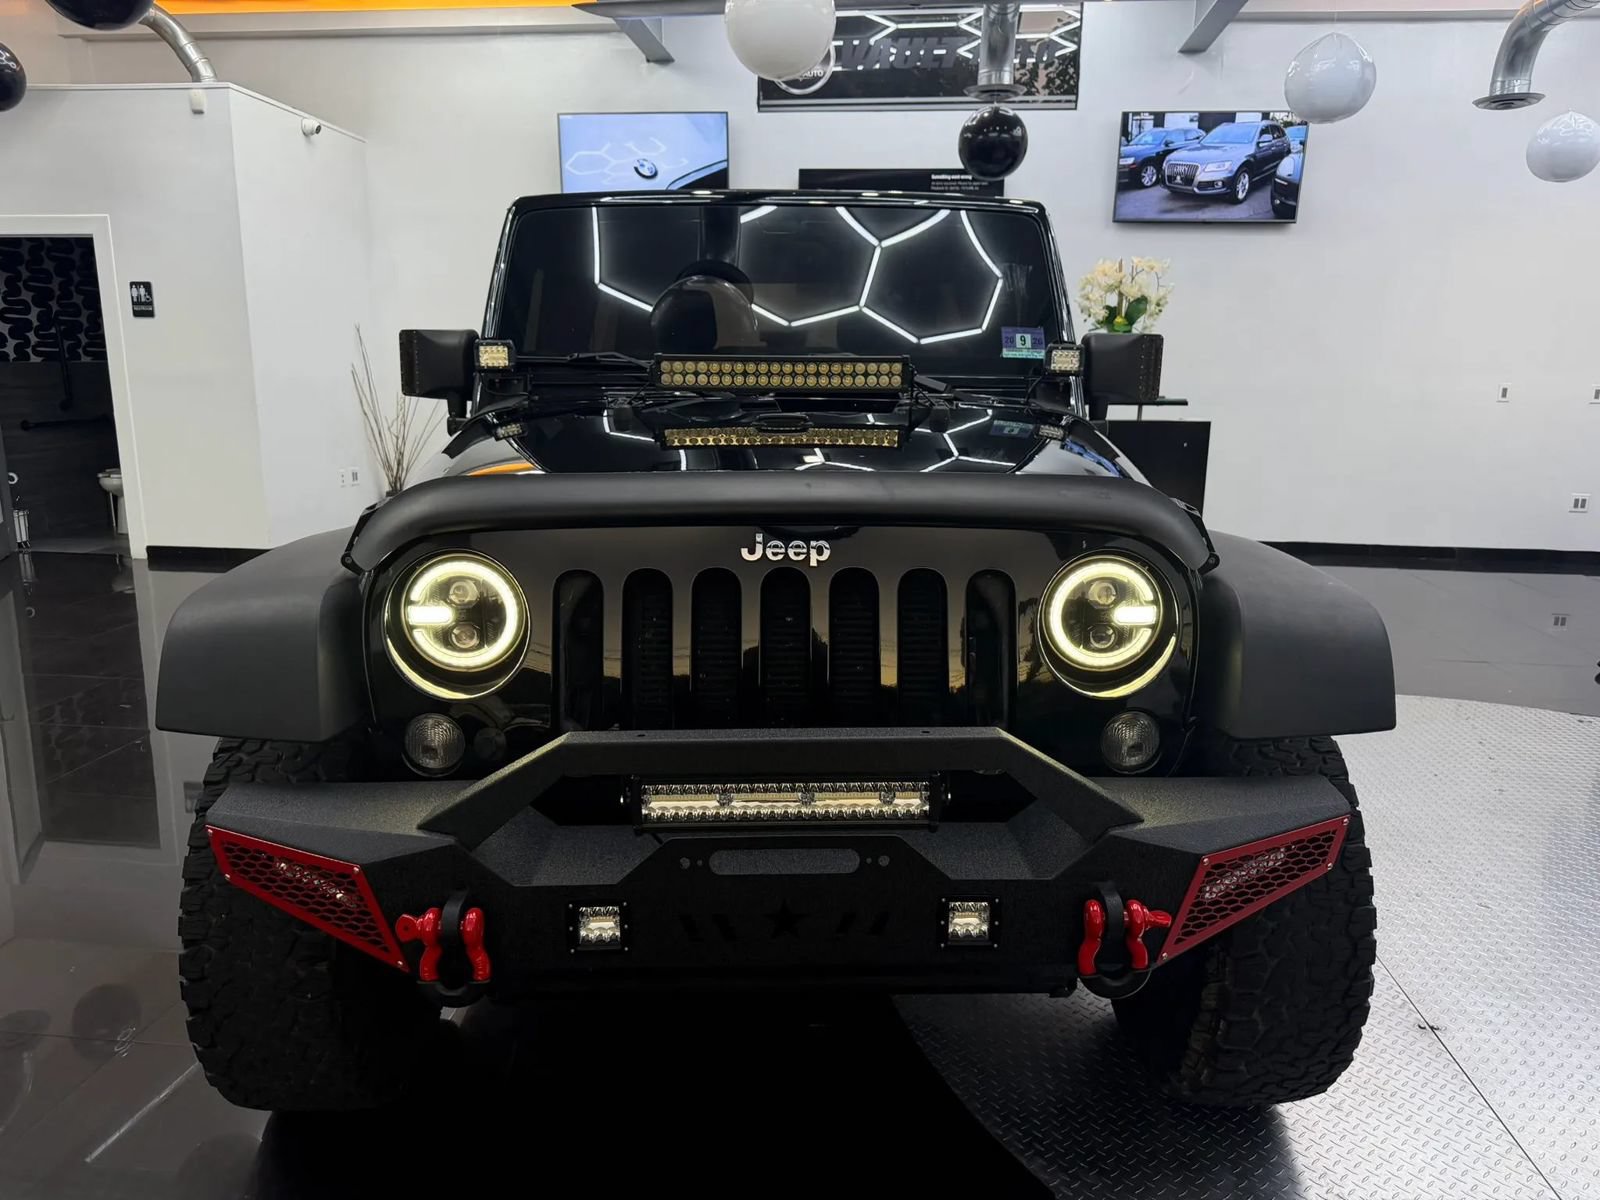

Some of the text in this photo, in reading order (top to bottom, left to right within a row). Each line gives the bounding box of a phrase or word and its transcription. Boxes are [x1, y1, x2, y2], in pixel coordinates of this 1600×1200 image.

[839, 37, 969, 70] VAULT
[1020, 335, 1026, 346] 9
[740, 533, 831, 567] Jeep
